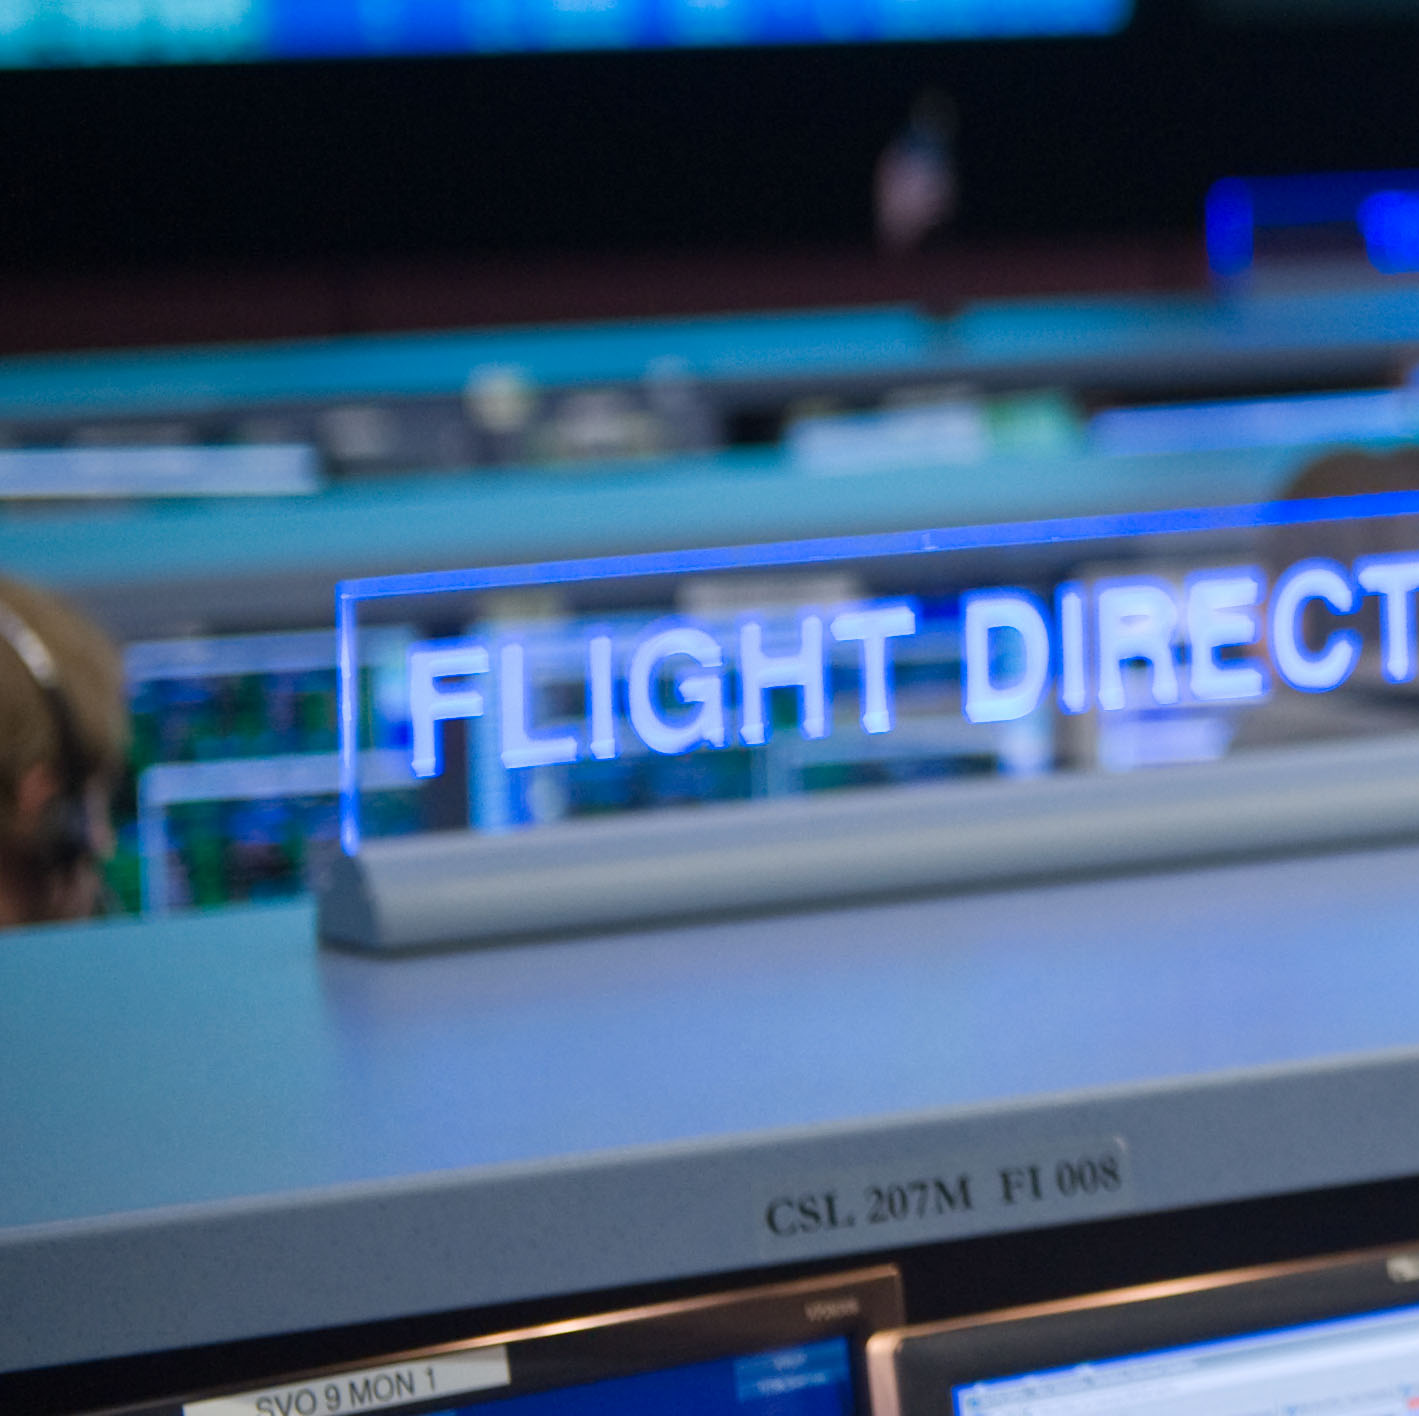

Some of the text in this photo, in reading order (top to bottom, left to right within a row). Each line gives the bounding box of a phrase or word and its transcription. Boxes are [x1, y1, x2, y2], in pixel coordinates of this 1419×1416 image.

[408, 603, 919, 778] FLIGHT
[765, 1188, 854, 1237] CSL
[865, 1172, 974, 1225] 207M
[1056, 1154, 1123, 1195] 008
[324, 1383, 342, 1412] 9
[350, 1370, 416, 1408] MON
[425, 1365, 436, 1392] 1
